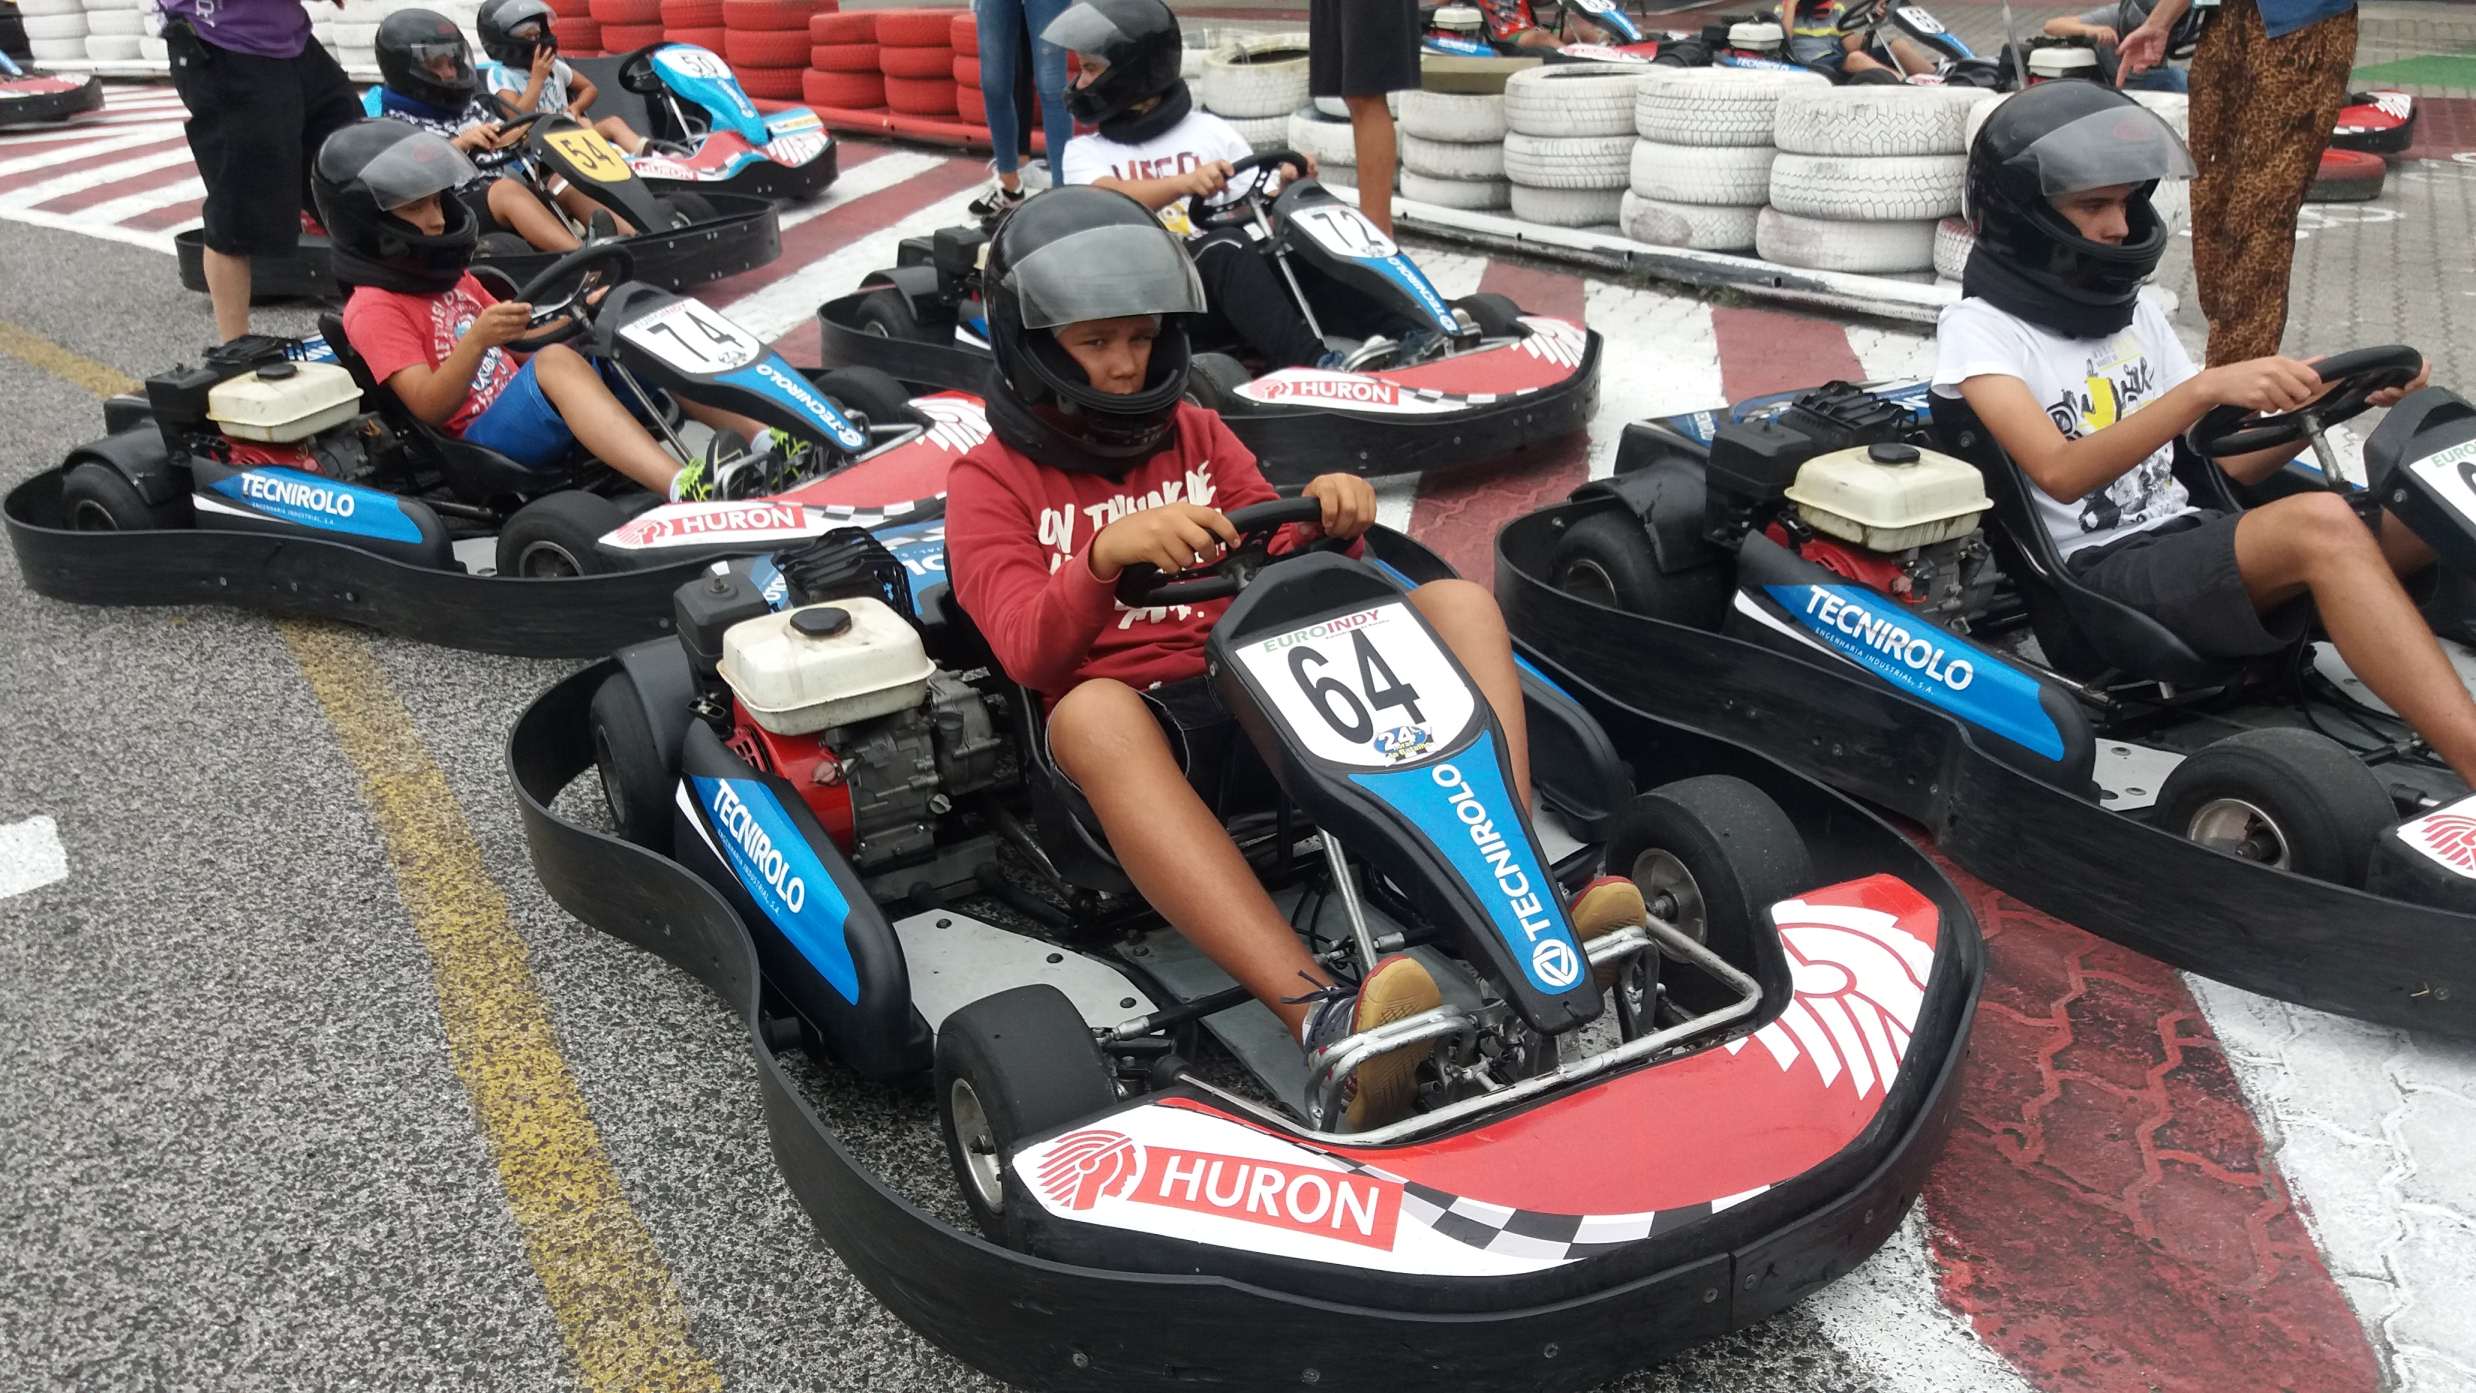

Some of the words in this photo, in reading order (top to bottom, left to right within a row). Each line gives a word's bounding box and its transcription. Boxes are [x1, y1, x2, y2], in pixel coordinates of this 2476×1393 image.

[560, 136, 616, 170] 54
[1311, 210, 1385, 249] 72
[1386, 256, 1447, 316] TECNIROLO
[646, 311, 745, 363] 74
[755, 363, 847, 431] TECNIROLO
[1300, 381, 1392, 404] HURON
[240, 472, 355, 518] TECNIROLO
[682, 507, 795, 533] HURON
[1263, 609, 1380, 653] EUROINDY
[1805, 584, 1975, 692] TECNIROLO
[1814, 626, 1864, 659] ENGENHARIA
[1864, 653, 1916, 687] INDUSTRIAL,
[1287, 628, 1427, 745] 64
[1378, 727, 1414, 752] 24
[713, 777, 805, 914] TECNIROLO
[1431, 763, 1551, 942] TECNIROLO
[1159, 1155, 1380, 1237] HURON
